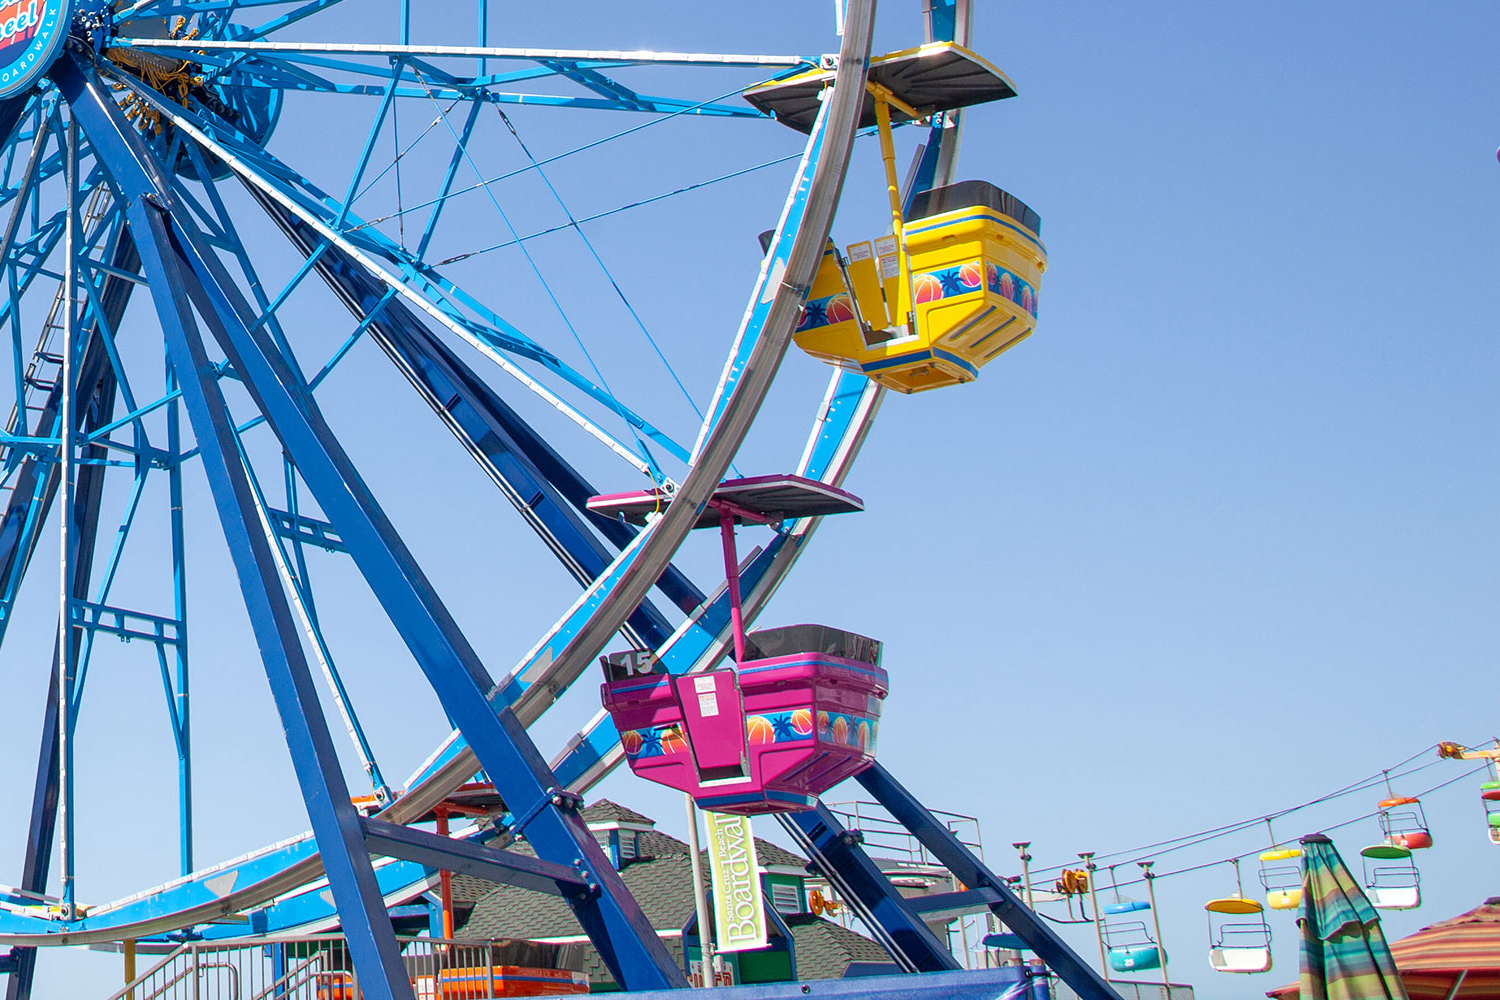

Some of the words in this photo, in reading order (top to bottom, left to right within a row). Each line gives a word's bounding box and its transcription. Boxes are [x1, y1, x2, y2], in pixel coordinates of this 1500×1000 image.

[619, 651, 653, 676] 15
[715, 828, 727, 858] Beach
[722, 869, 732, 893] Cruz
[726, 894, 735, 922] Santa
